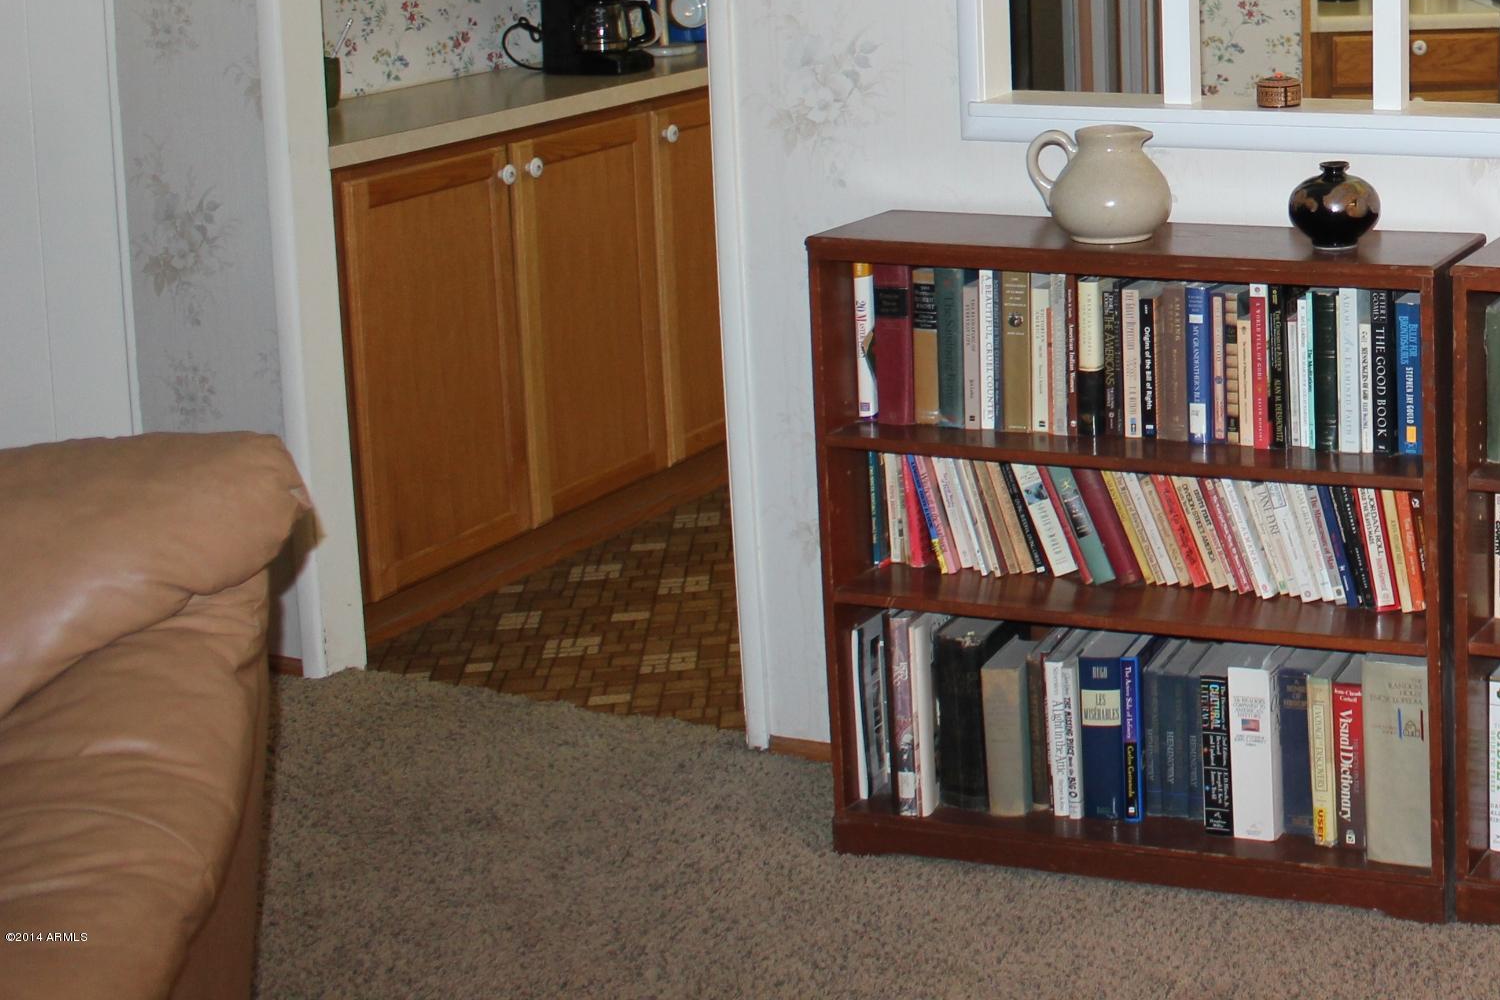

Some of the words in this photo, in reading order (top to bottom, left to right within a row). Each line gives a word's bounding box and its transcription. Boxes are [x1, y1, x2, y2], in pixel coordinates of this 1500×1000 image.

[984, 284, 993, 340] BEAUTIFUL,
[1104, 314, 1115, 330] THE
[1067, 323, 1075, 351] American
[1142, 326, 1151, 345] Origins
[1192, 326, 1201, 336] MY
[1375, 326, 1386, 353] THE
[985, 342, 994, 372] CRUEL
[1104, 332, 1115, 386] AMERICANS
[1144, 348, 1152, 358] of
[1376, 356, 1386, 396] GOOD
[1405, 366, 1414, 393] STEPHEN
[986, 375, 994, 421] COUNTRY
[1144, 390, 1153, 410] Rights
[1405, 393, 1414, 404] JAY
[1377, 399, 1388, 438] BOOK
[1406, 405, 1415, 424] GOULD
[1309, 495, 1319, 509] The
[1326, 555, 1335, 570] Man
[1368, 496, 1380, 534] JORDAN,
[1374, 534, 1384, 557] ROLL
[1201, 535, 1217, 564] AMERICA
[1124, 666, 1132, 678] The
[1052, 699, 1063, 708] A
[1095, 693, 1107, 707] LES
[1125, 697, 1133, 710] Side
[1200, 684, 1211, 729] LITERACY
[1209, 683, 1220, 730] CULTURAL
[1050, 708, 1065, 730] Light
[1338, 708, 1353, 750] Visual
[1054, 731, 1065, 740] in
[1055, 740, 1066, 753] the
[1055, 754, 1068, 776] Attic
[1126, 745, 1135, 765] Carlos
[1166, 730, 1175, 785] HEMINGWAY
[1189, 735, 1198, 789] HEMINGWAY
[1339, 751, 1353, 822] Dictionary
